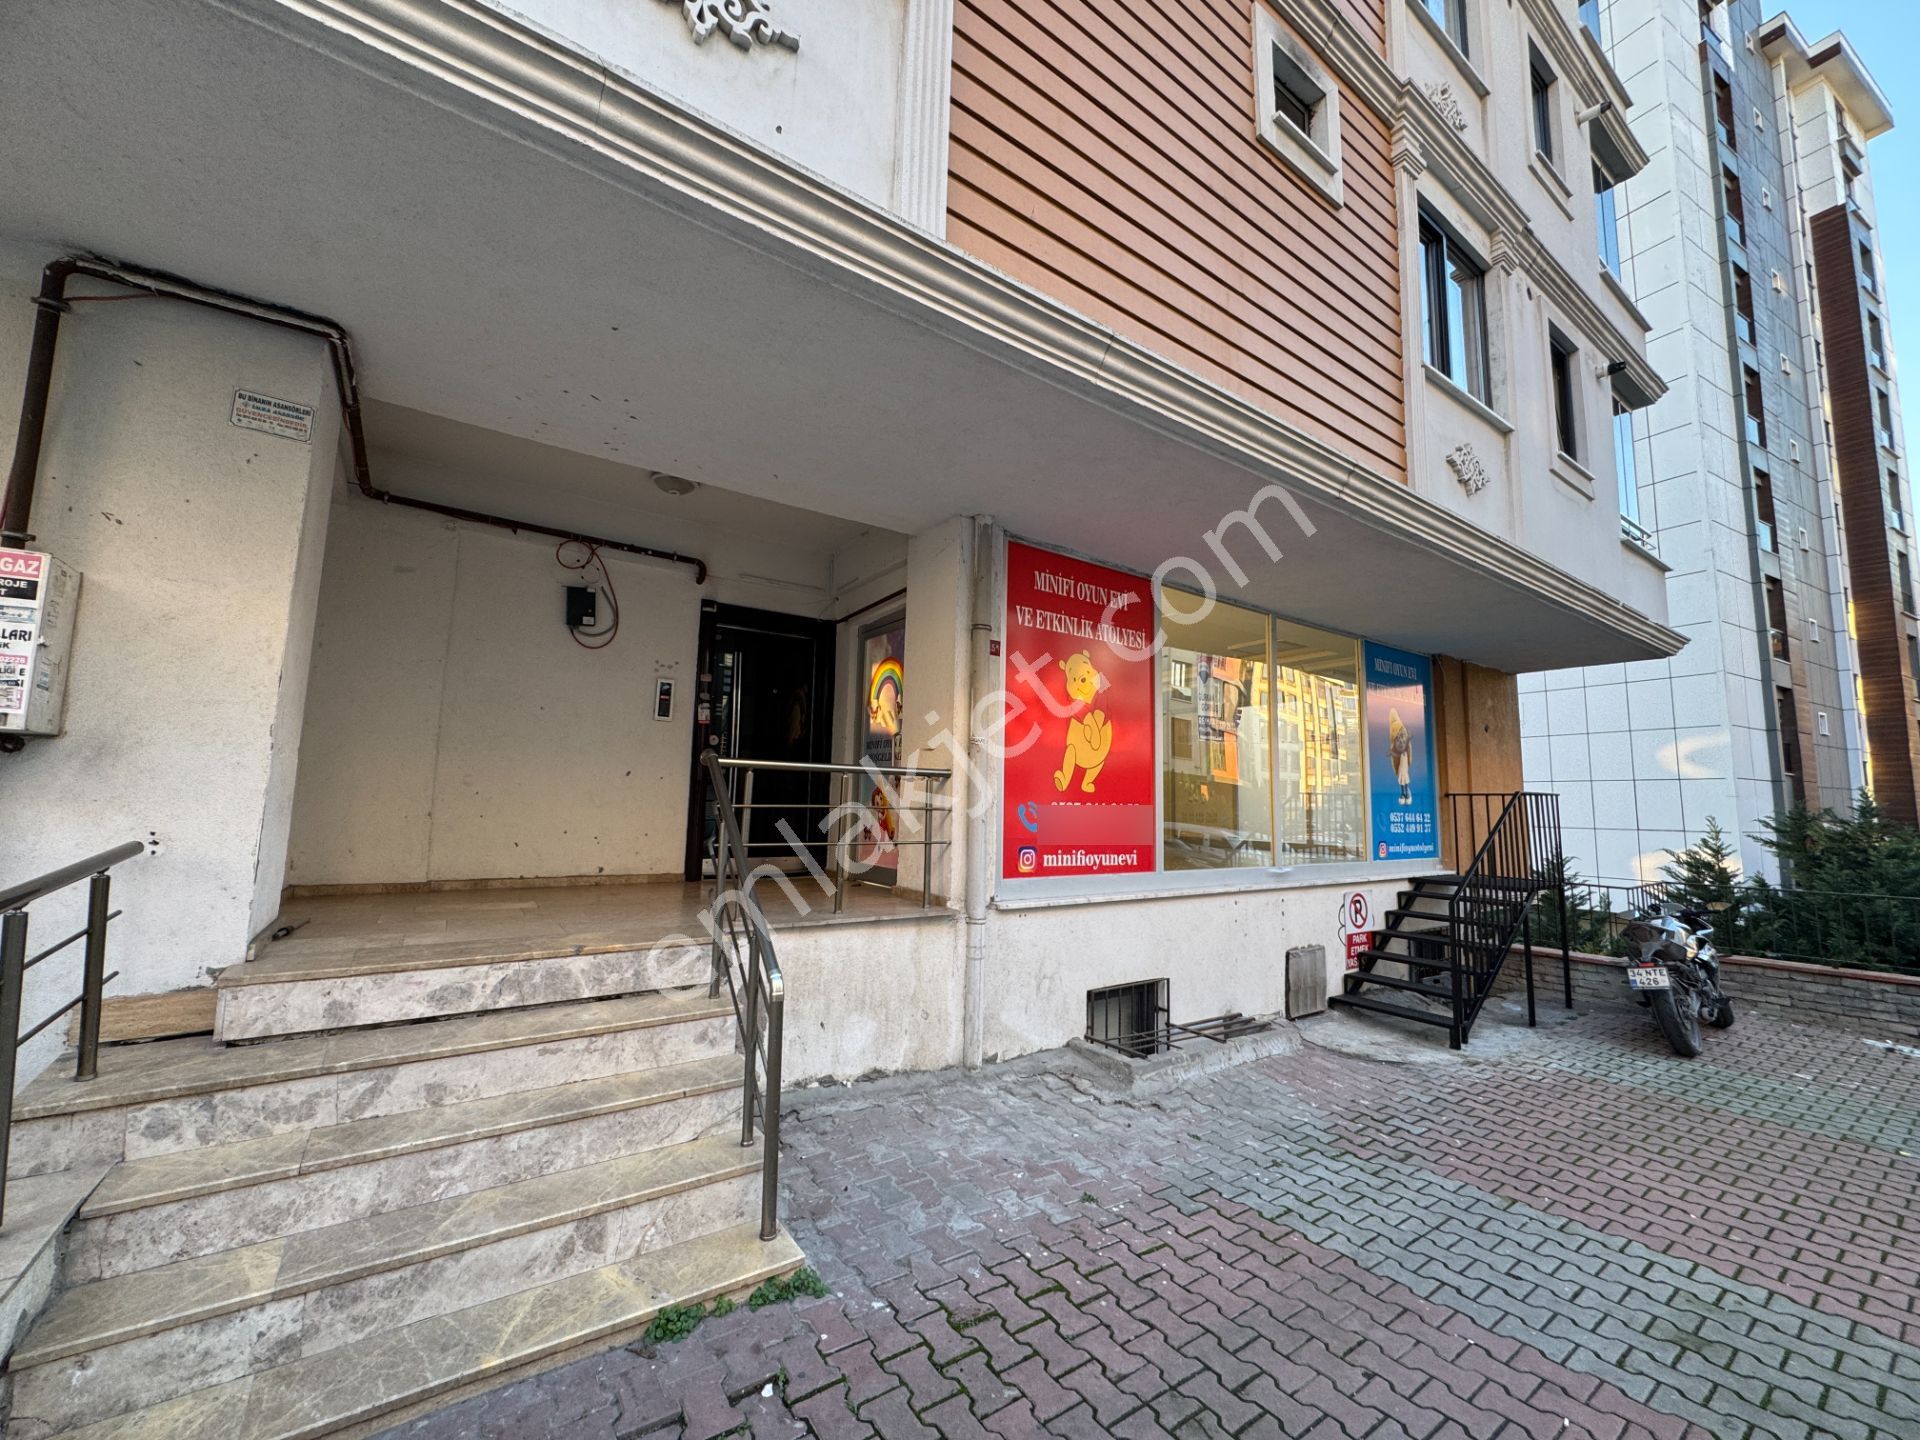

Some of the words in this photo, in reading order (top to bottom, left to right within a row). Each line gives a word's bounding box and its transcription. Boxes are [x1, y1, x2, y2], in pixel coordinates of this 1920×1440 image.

[238, 392, 247, 400] BU
[0, 557, 40, 575] GAZ
[1034, 569, 1075, 599] MİNİFİ
[1077, 581, 1108, 606] OYUN
[1015, 605, 1033, 628] VE
[1035, 610, 1093, 639] ETKİNLİK
[1043, 849, 1137, 870] minifioyunevi
[1352, 933, 1368, 944] PARK
[1347, 957, 1358, 968] YAS
[1630, 968, 1643, 978] 34
[1639, 977, 1660, 986] 426
